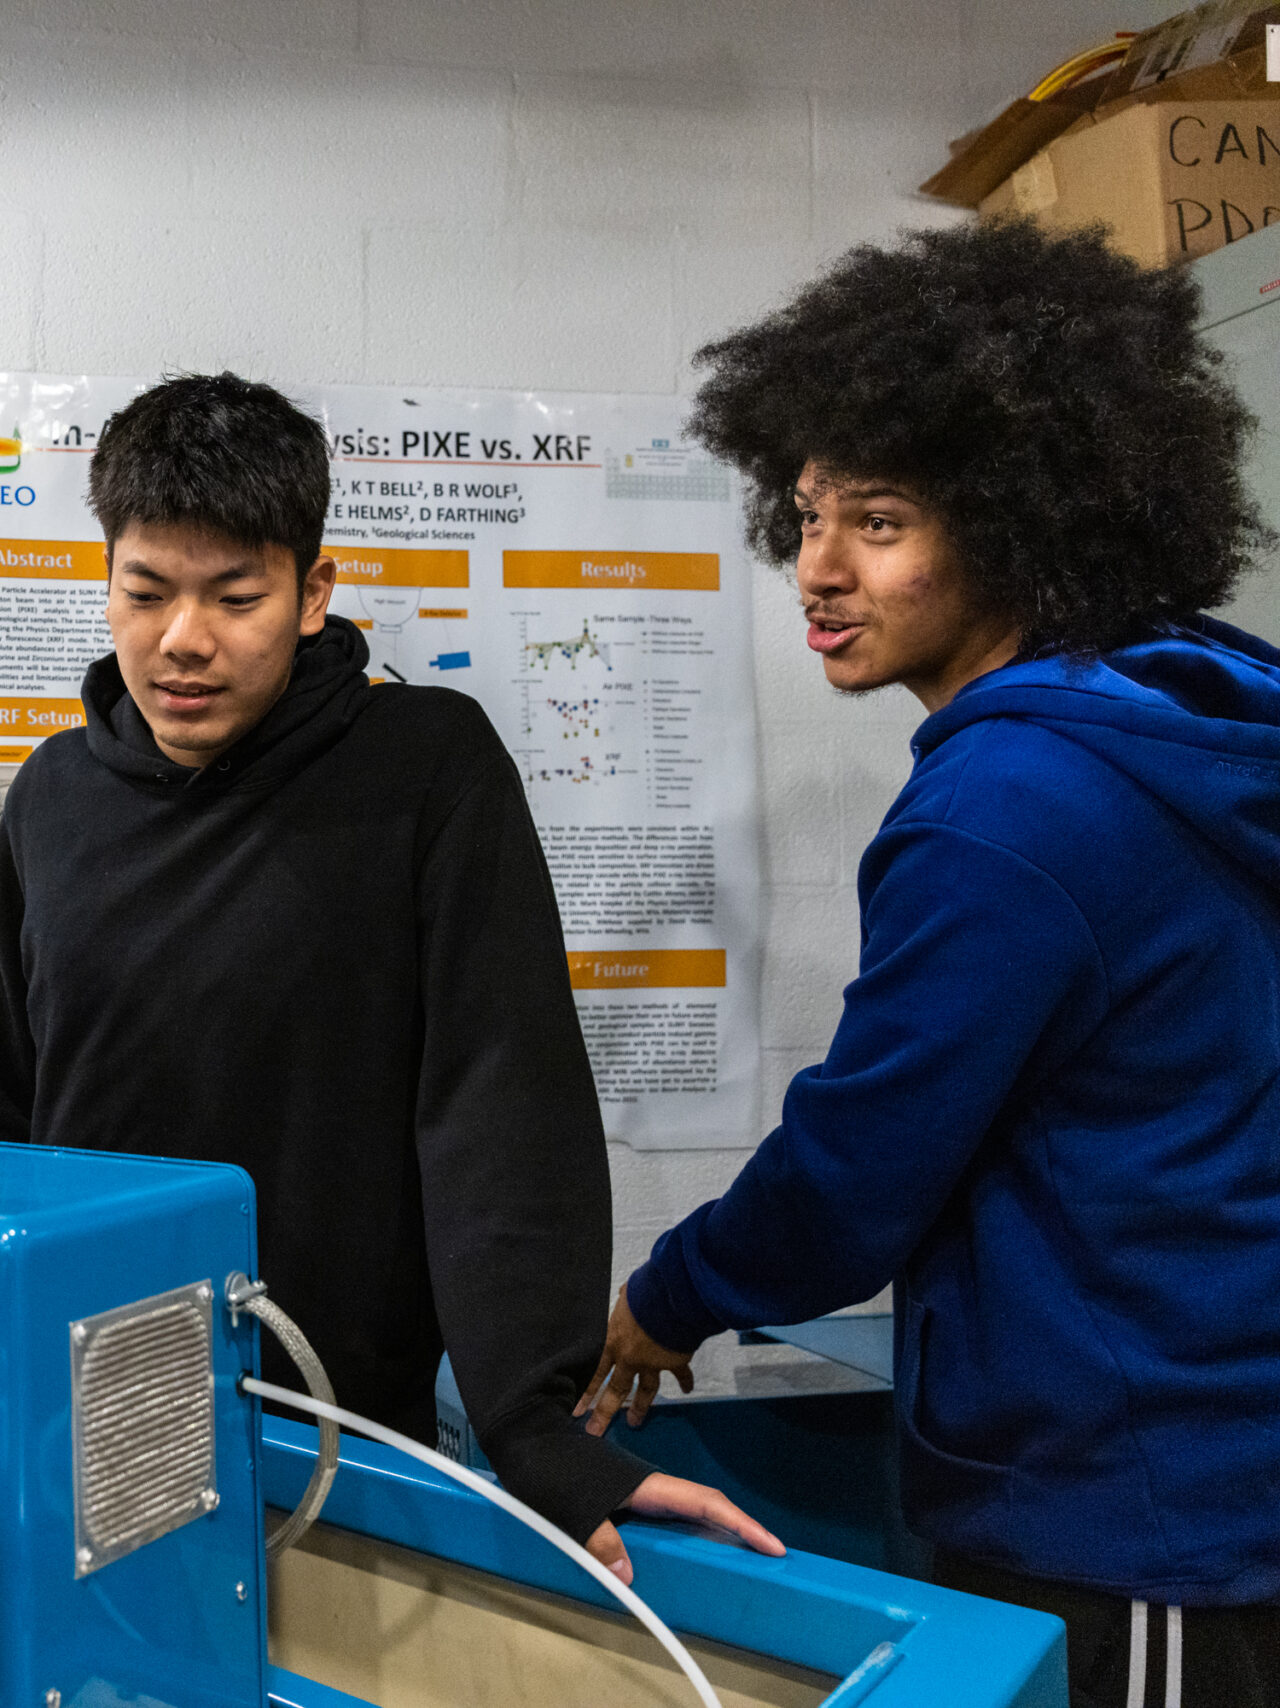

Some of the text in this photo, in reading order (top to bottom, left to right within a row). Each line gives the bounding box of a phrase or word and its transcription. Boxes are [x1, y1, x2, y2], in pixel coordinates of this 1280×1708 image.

[402, 431, 470, 458] PIXE
[481, 439, 521, 460] vs.
[532, 434, 591, 461] XRF
[351, 480, 362, 495] K
[366, 481, 376, 495] T
[434, 483, 444, 497] B
[449, 483, 459, 498] R
[334, 504, 343, 519] E
[420, 507, 431, 521] D
[431, 529, 475, 540] Sciences
[581, 560, 646, 579] Results
[27, 708, 82, 727] Setup
[593, 961, 650, 978] Future
